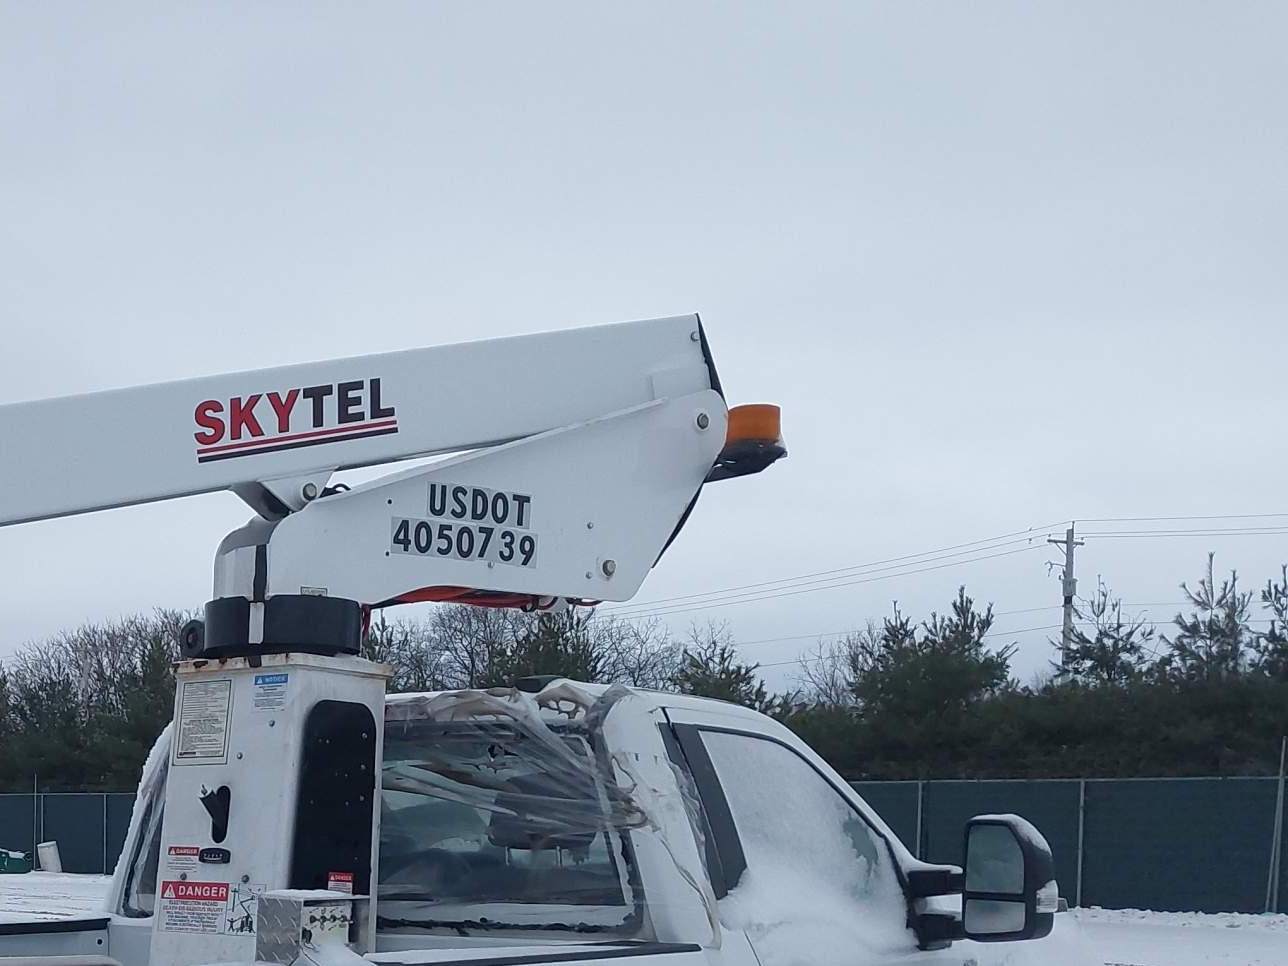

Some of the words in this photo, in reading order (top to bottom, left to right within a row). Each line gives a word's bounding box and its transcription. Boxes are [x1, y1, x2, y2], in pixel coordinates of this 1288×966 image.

[193, 377, 396, 446] SKYTEL
[428, 483, 532, 527] USDOT
[392, 519, 536, 567] 4050739
[178, 885, 227, 897] DANGER
